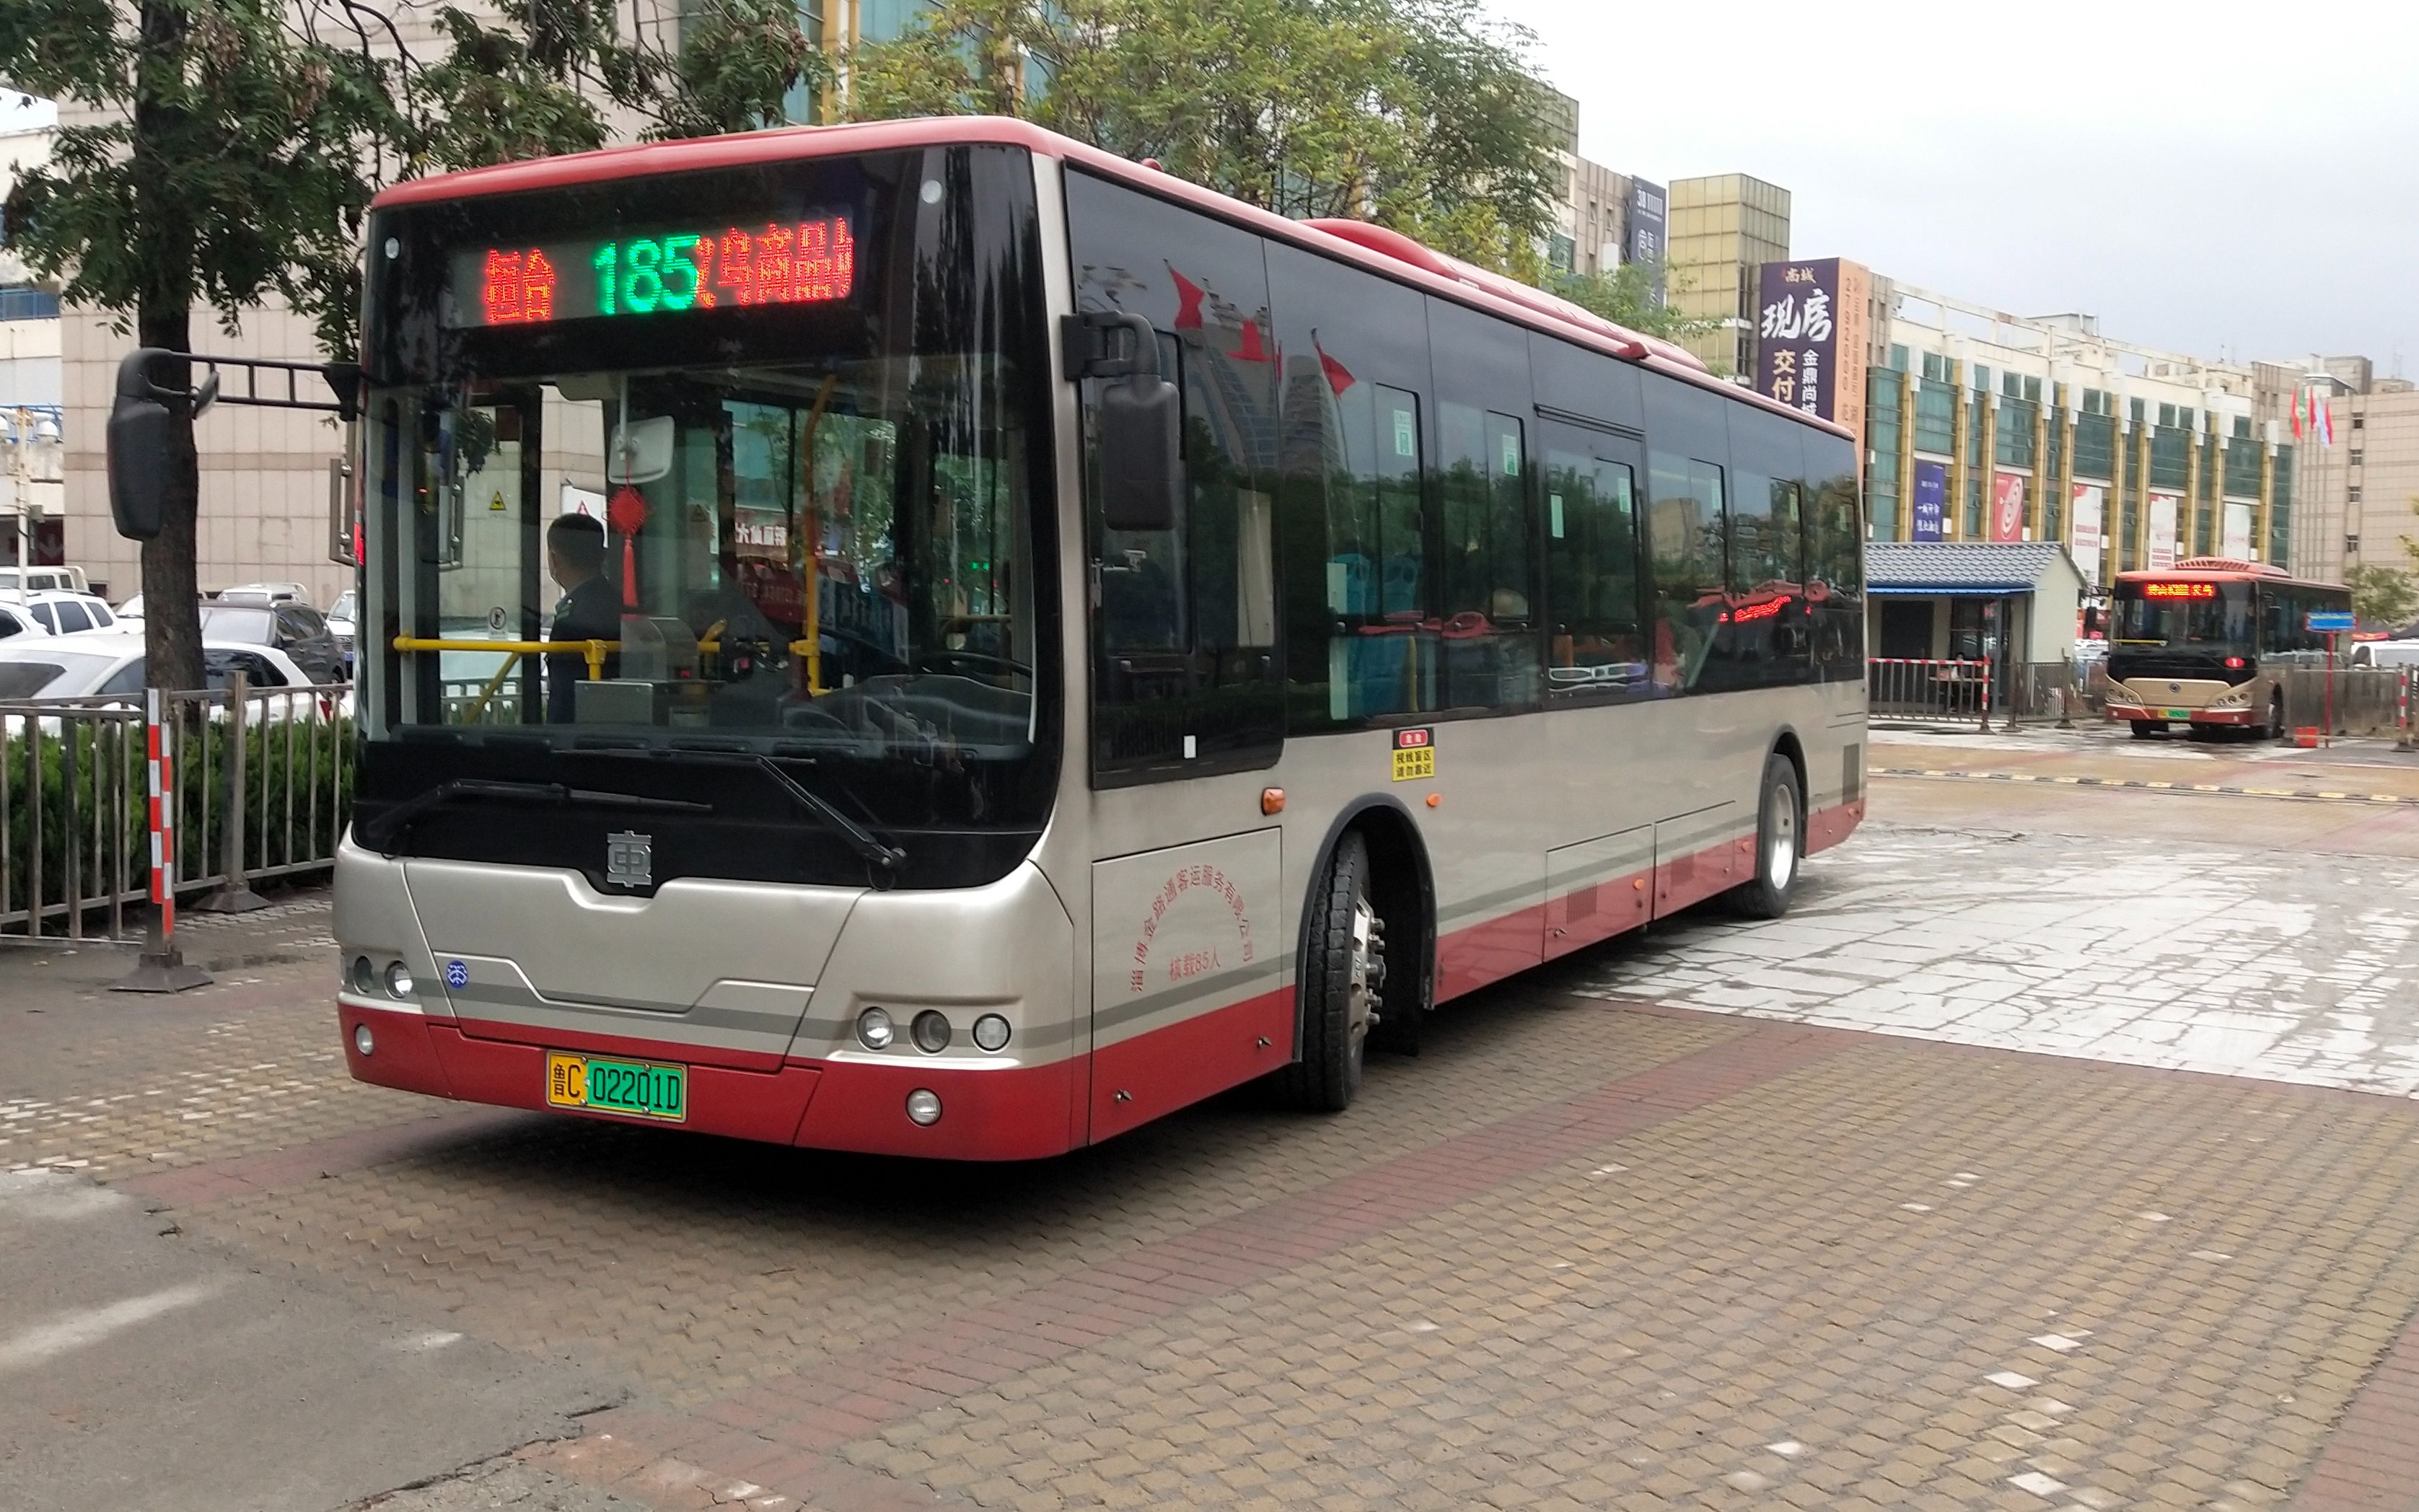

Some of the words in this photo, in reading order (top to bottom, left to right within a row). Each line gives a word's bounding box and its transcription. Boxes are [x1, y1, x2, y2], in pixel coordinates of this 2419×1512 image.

[594, 235, 701, 315] 185
[1761, 288, 1832, 341] 现房
[1771, 349, 1796, 402] 交付
[1169, 946, 1221, 982] 核载85人
